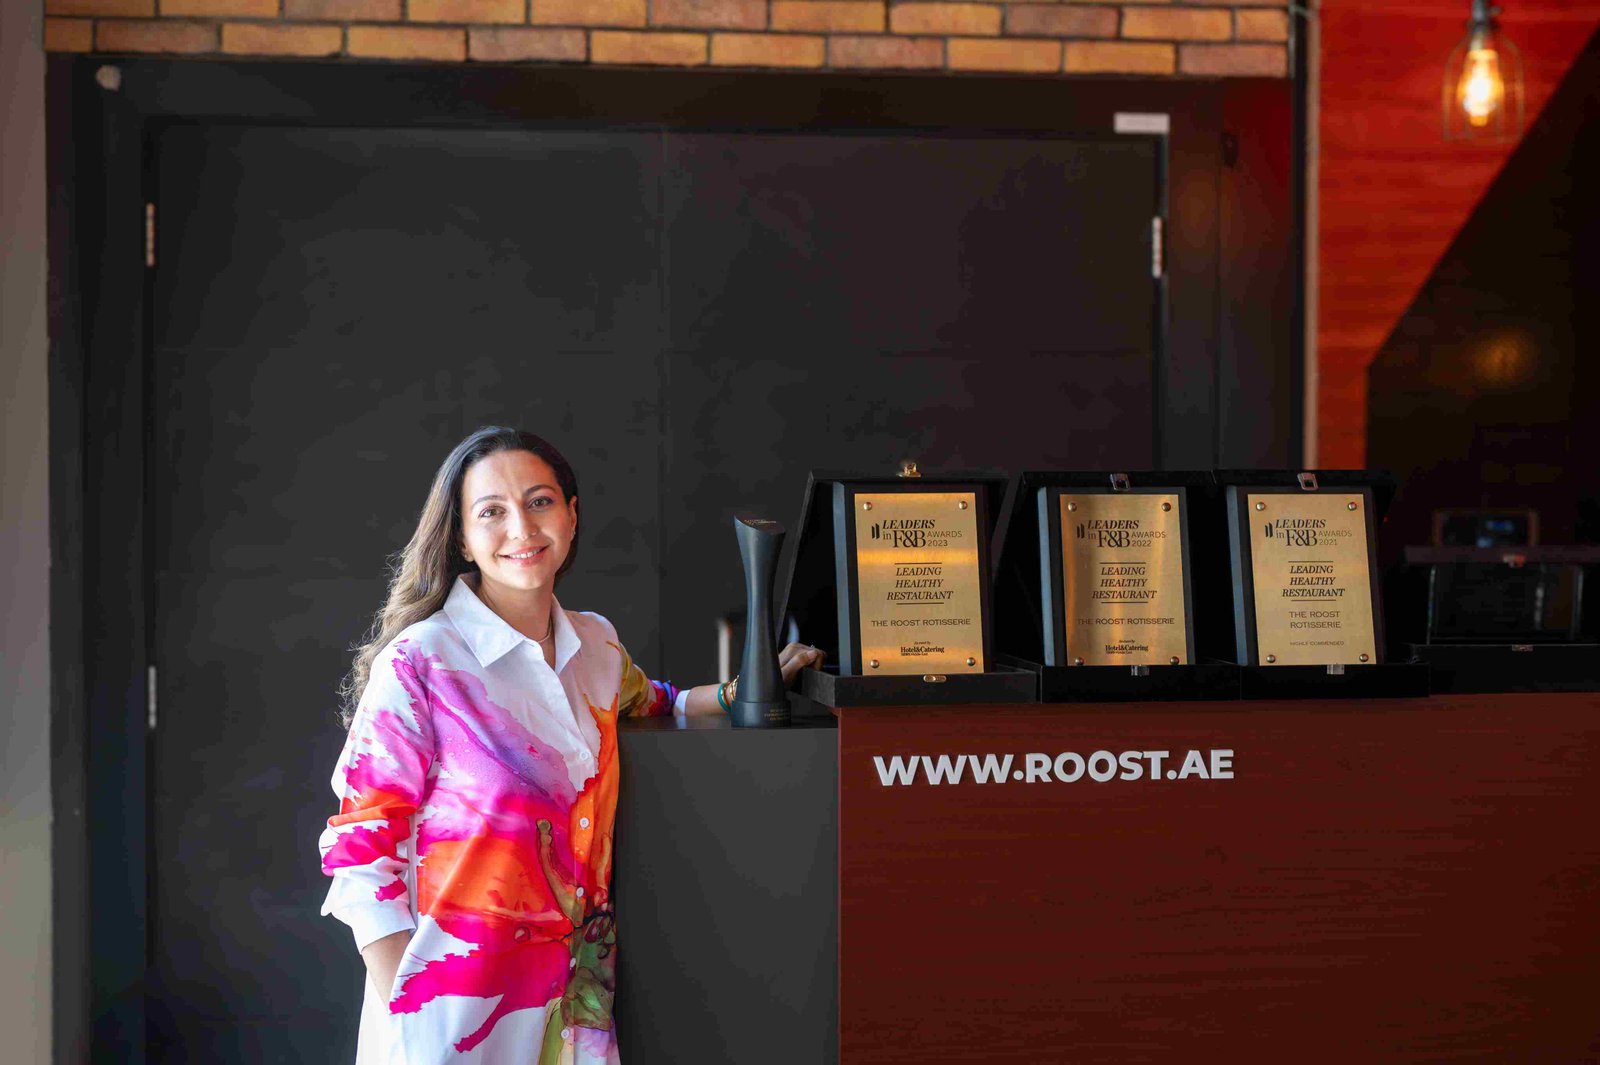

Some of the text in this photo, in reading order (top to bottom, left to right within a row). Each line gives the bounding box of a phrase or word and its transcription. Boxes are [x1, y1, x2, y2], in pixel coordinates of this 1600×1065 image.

[882, 520, 935, 529] LEADERS
[1087, 520, 1139, 529] LEADERS
[1275, 519, 1326, 528] LEADERS
[883, 531, 892, 540] in
[893, 530, 926, 548] F&B
[1088, 532, 1096, 540] in
[1097, 531, 1130, 548] F&B
[1276, 530, 1284, 539] in
[1285, 530, 1317, 546] F&B
[896, 567, 942, 576] LEADING
[1101, 567, 1145, 575] LEADING
[1290, 566, 1333, 574] LEADING
[895, 579, 944, 588] HEALTHY
[1100, 579, 1148, 587] HEALTHY
[1289, 577, 1336, 585] HEALTHY
[887, 591, 953, 600] RESTAURANT
[1092, 591, 1157, 599] RESTAURANT
[1282, 589, 1345, 597] RESTAURANT
[873, 749, 1235, 786] WWW.ROOST.AE
